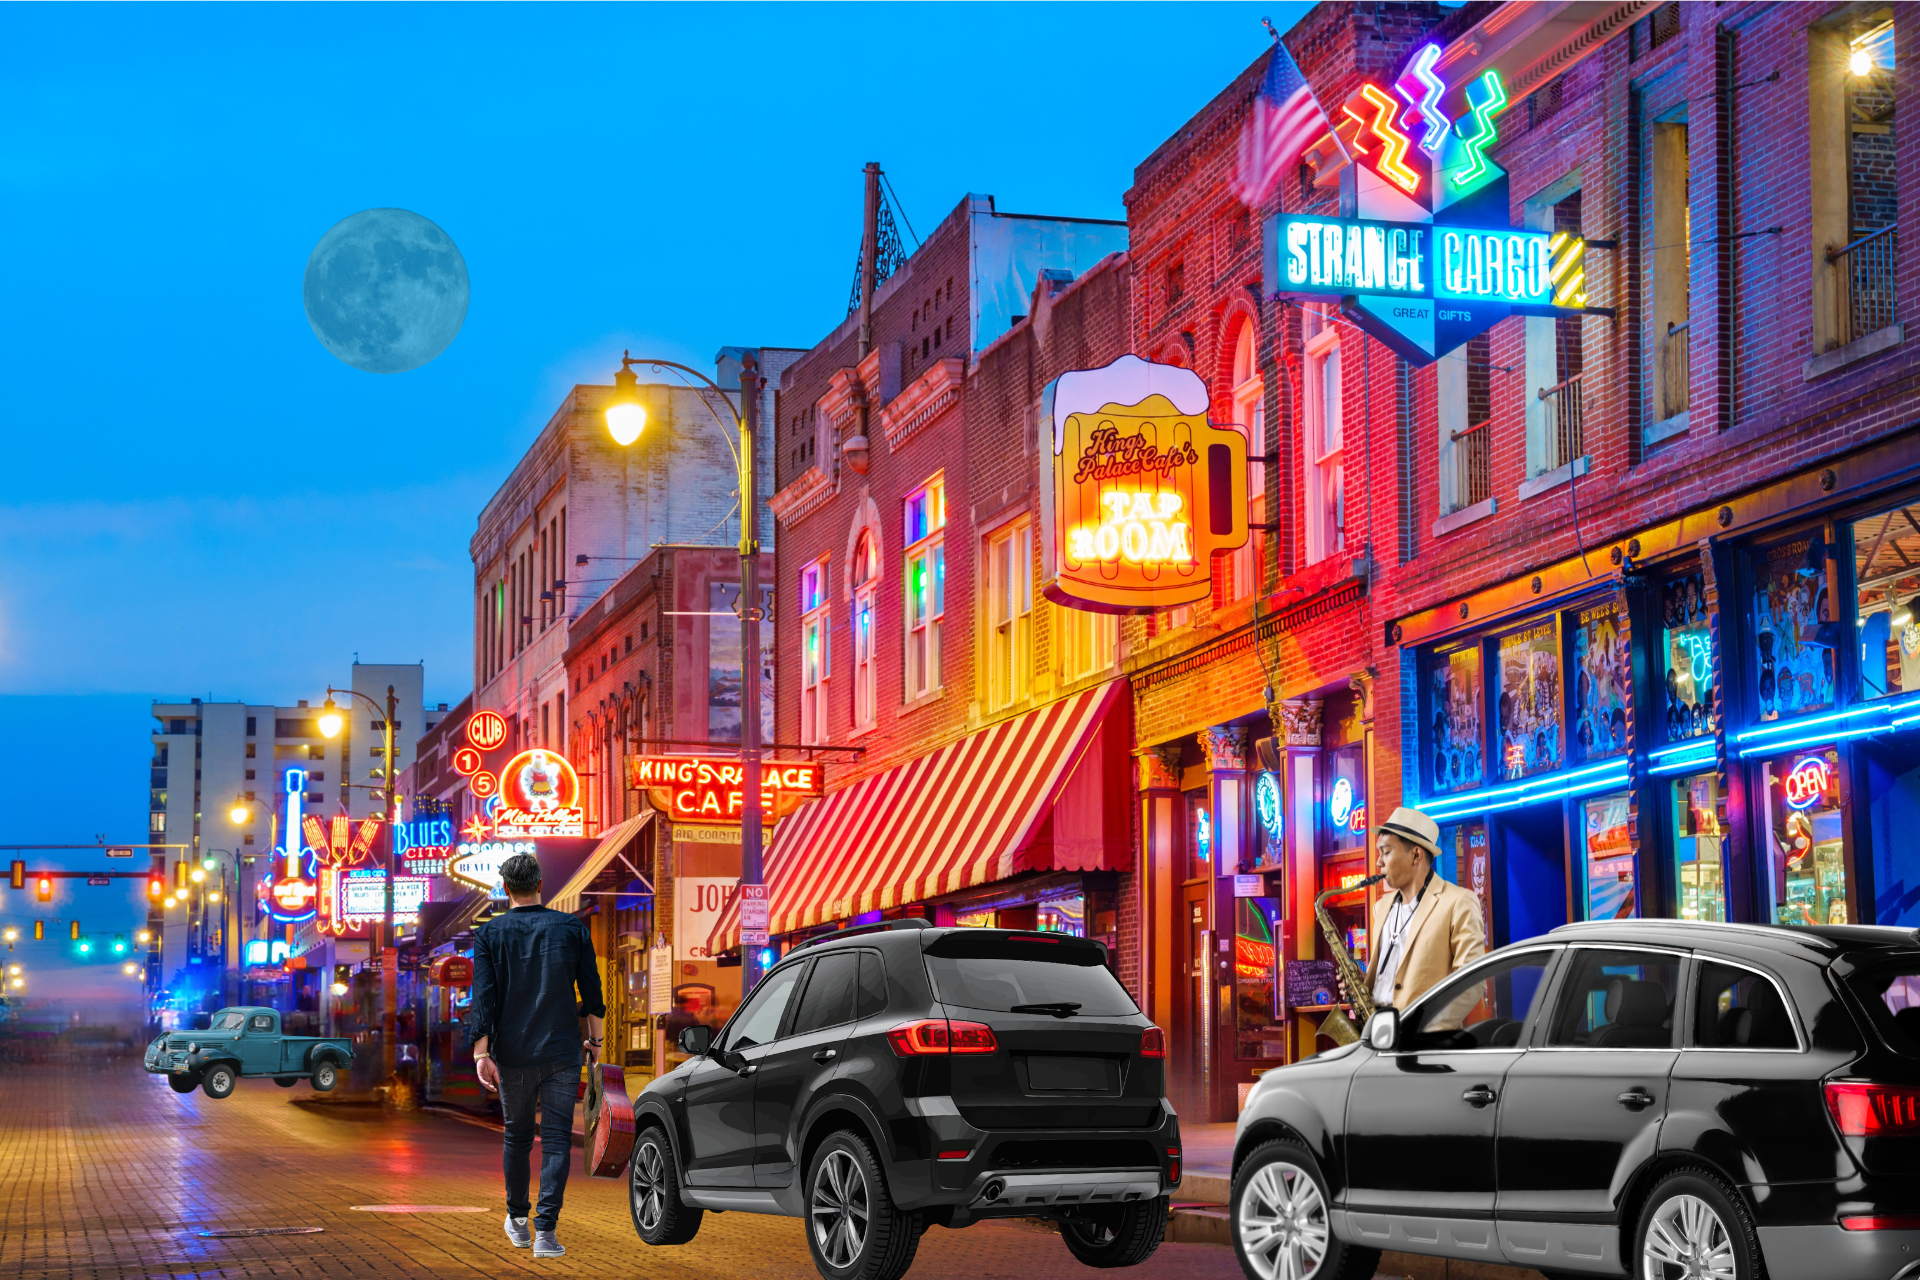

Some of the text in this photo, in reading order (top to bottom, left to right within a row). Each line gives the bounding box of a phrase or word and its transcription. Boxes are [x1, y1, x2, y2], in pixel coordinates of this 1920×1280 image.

[1287, 221, 1542, 301] STRANGE CARGO
[1392, 307, 1472, 321] GREAT GIFTS
[1084, 427, 1147, 460] Kings
[1073, 441, 1200, 485] Palace Cafe's
[1102, 490, 1183, 525] TAP
[1070, 520, 1194, 562] ROOM
[1766, 539, 1811, 562] CROSSROA
[471, 714, 503, 746] CLUB
[461, 753, 472, 770] 1
[640, 759, 813, 789] KING'S PAACE
[478, 776, 491, 793] 5
[1785, 766, 1828, 802] OPEN
[498, 808, 536, 824] Miss
[397, 820, 451, 855] BLUES
[674, 829, 769, 842] AIR CONDITID
[405, 846, 450, 859] CITY
[411, 866, 444, 875] STORE
[746, 887, 763, 898] NO
